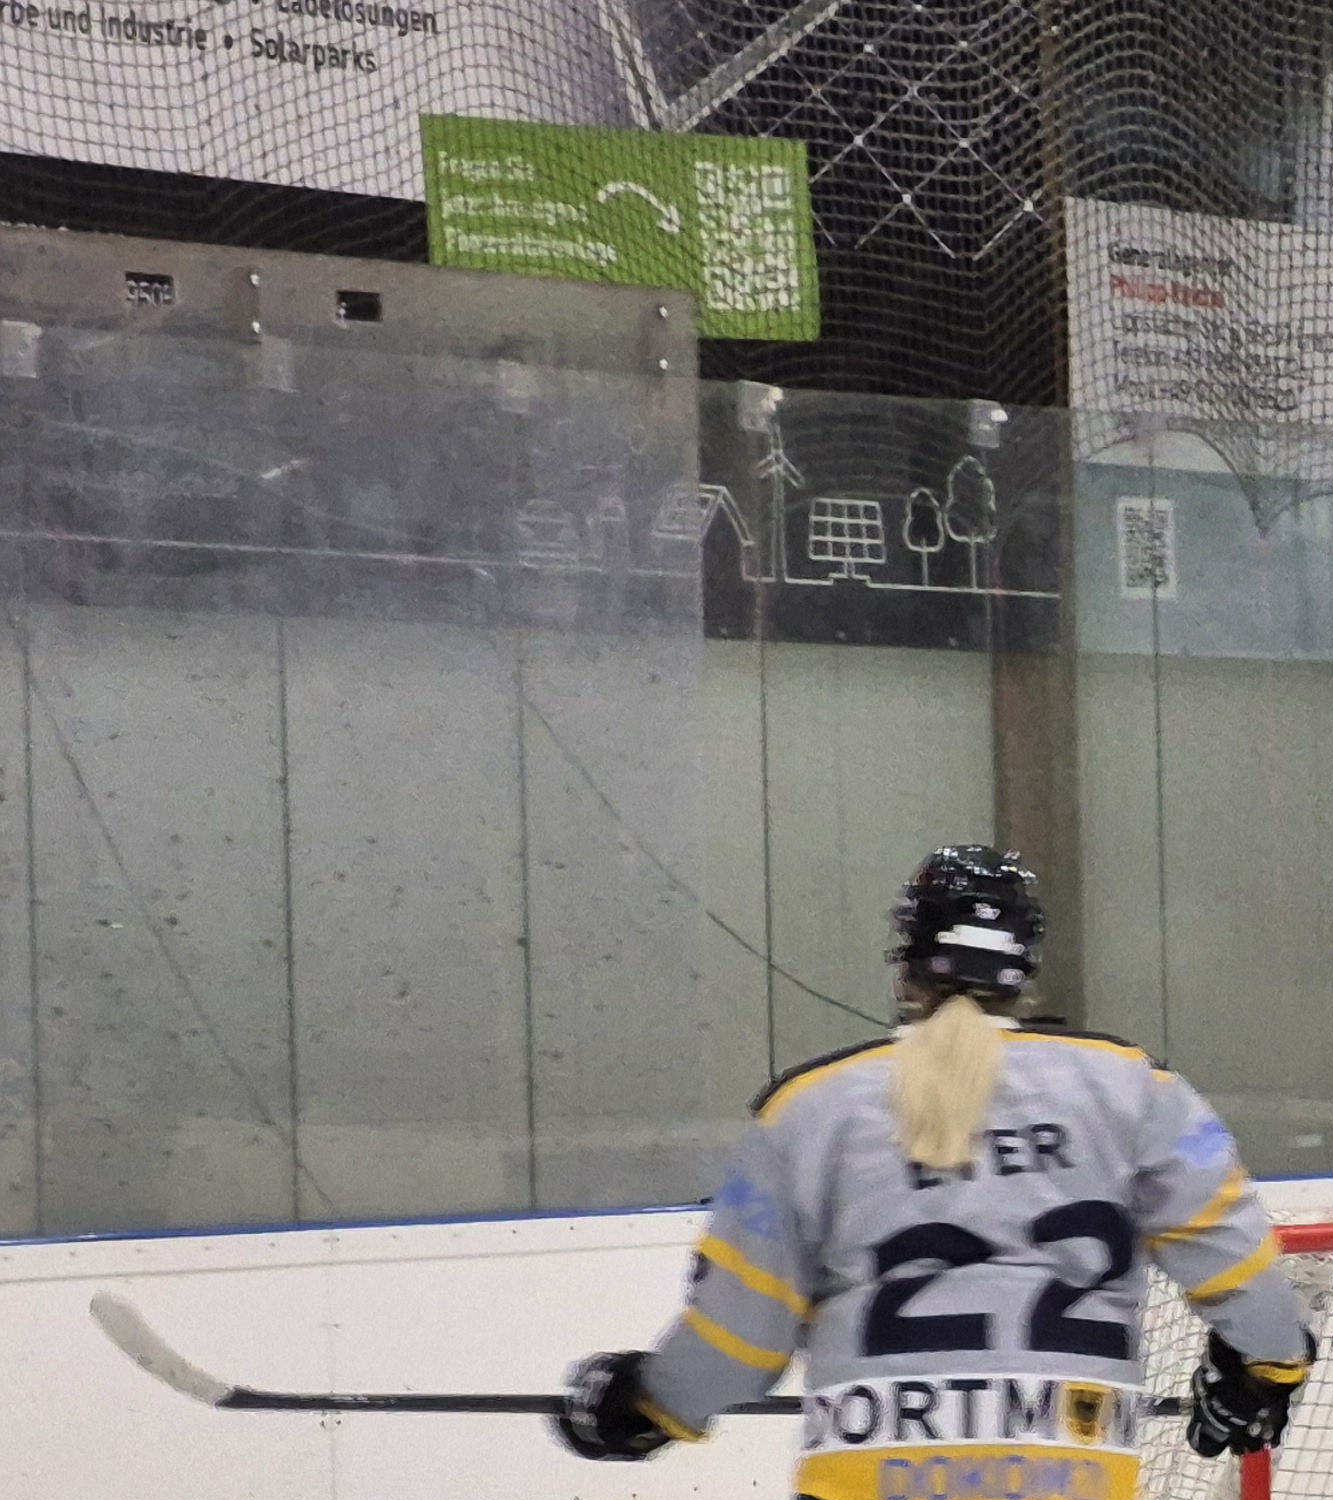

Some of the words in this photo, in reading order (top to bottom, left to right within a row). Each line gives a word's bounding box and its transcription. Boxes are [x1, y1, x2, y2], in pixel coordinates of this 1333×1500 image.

[47, 2, 92, 35] und
[101, 5, 206, 50] Industrie
[250, 26, 378, 73] Solarparks
[862, 1199, 1137, 1357] 22
